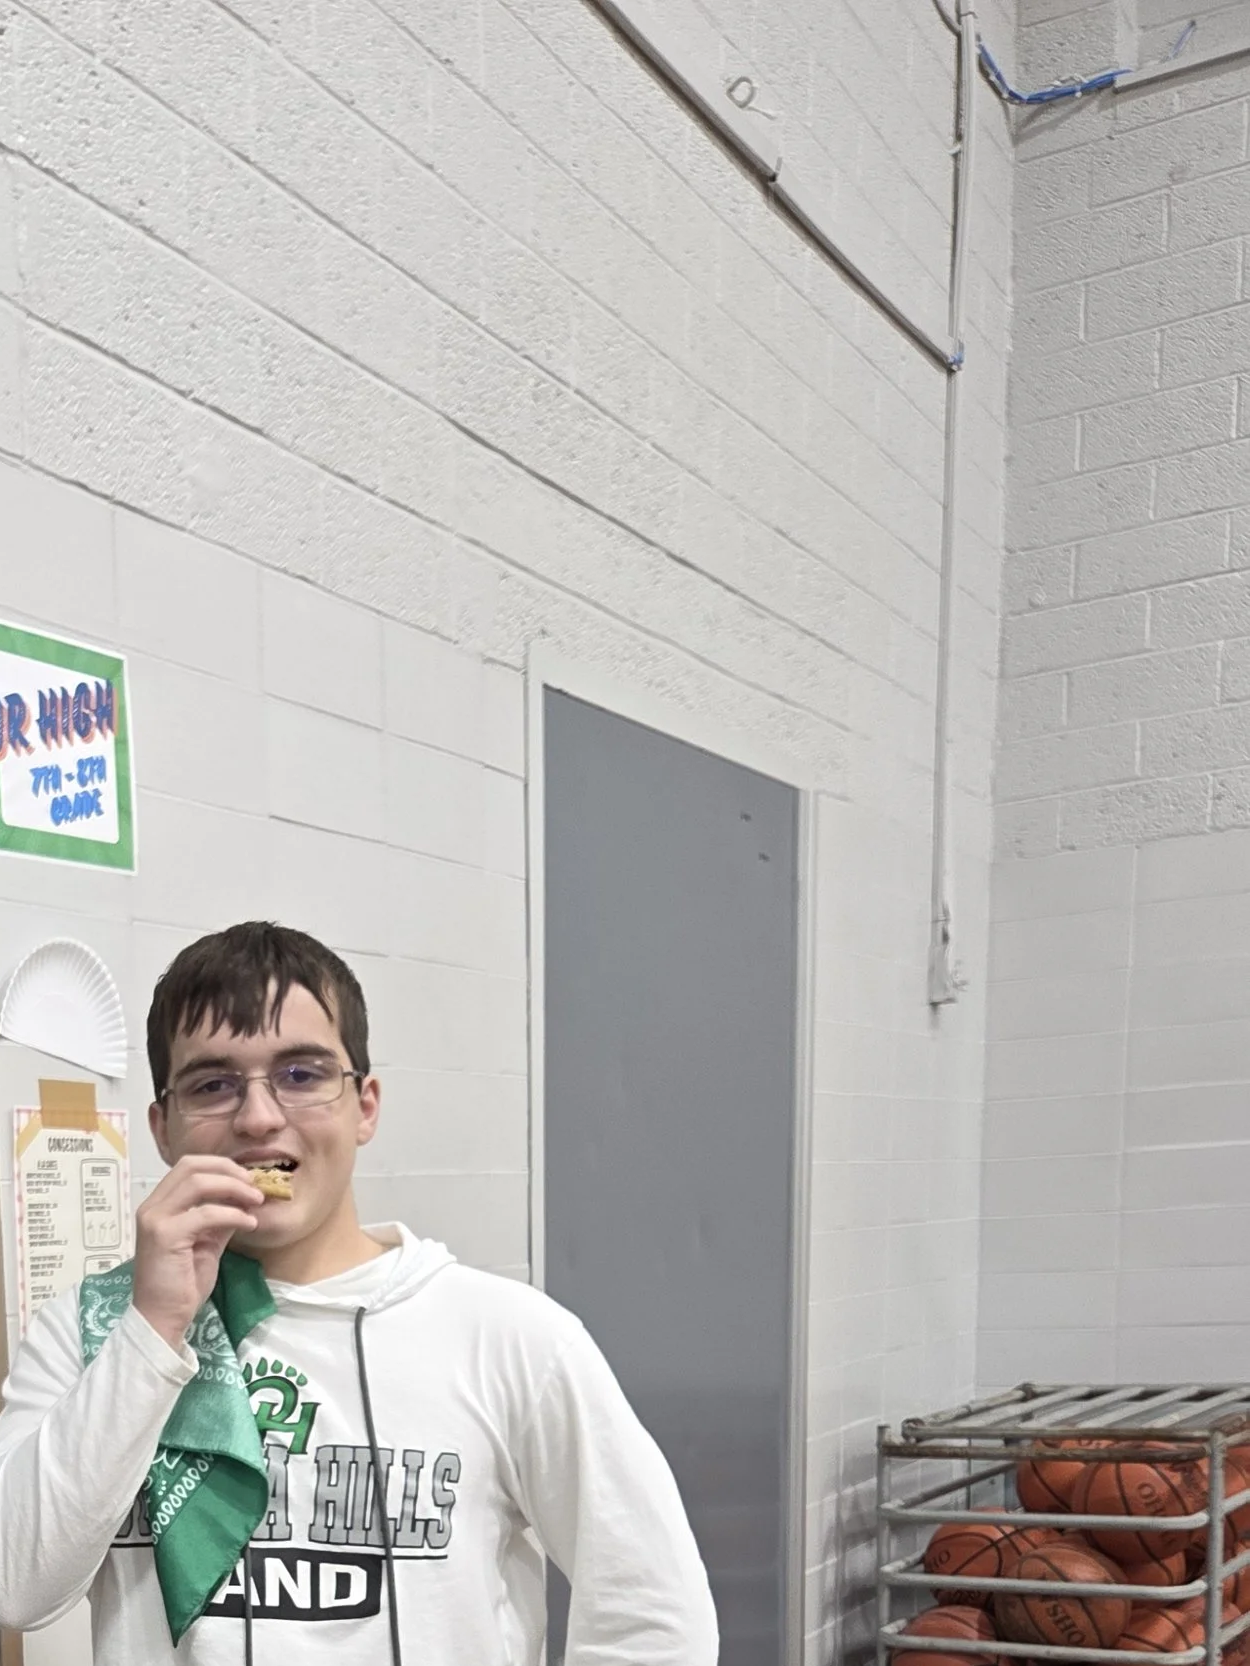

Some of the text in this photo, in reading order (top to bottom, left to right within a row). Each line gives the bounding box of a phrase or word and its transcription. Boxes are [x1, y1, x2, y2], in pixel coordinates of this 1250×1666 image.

[36, 678, 117, 752] HIGH
[50, 788, 104, 826] GRADE
[308, 1444, 462, 1549] HILLS
[210, 1556, 368, 1610] AND
